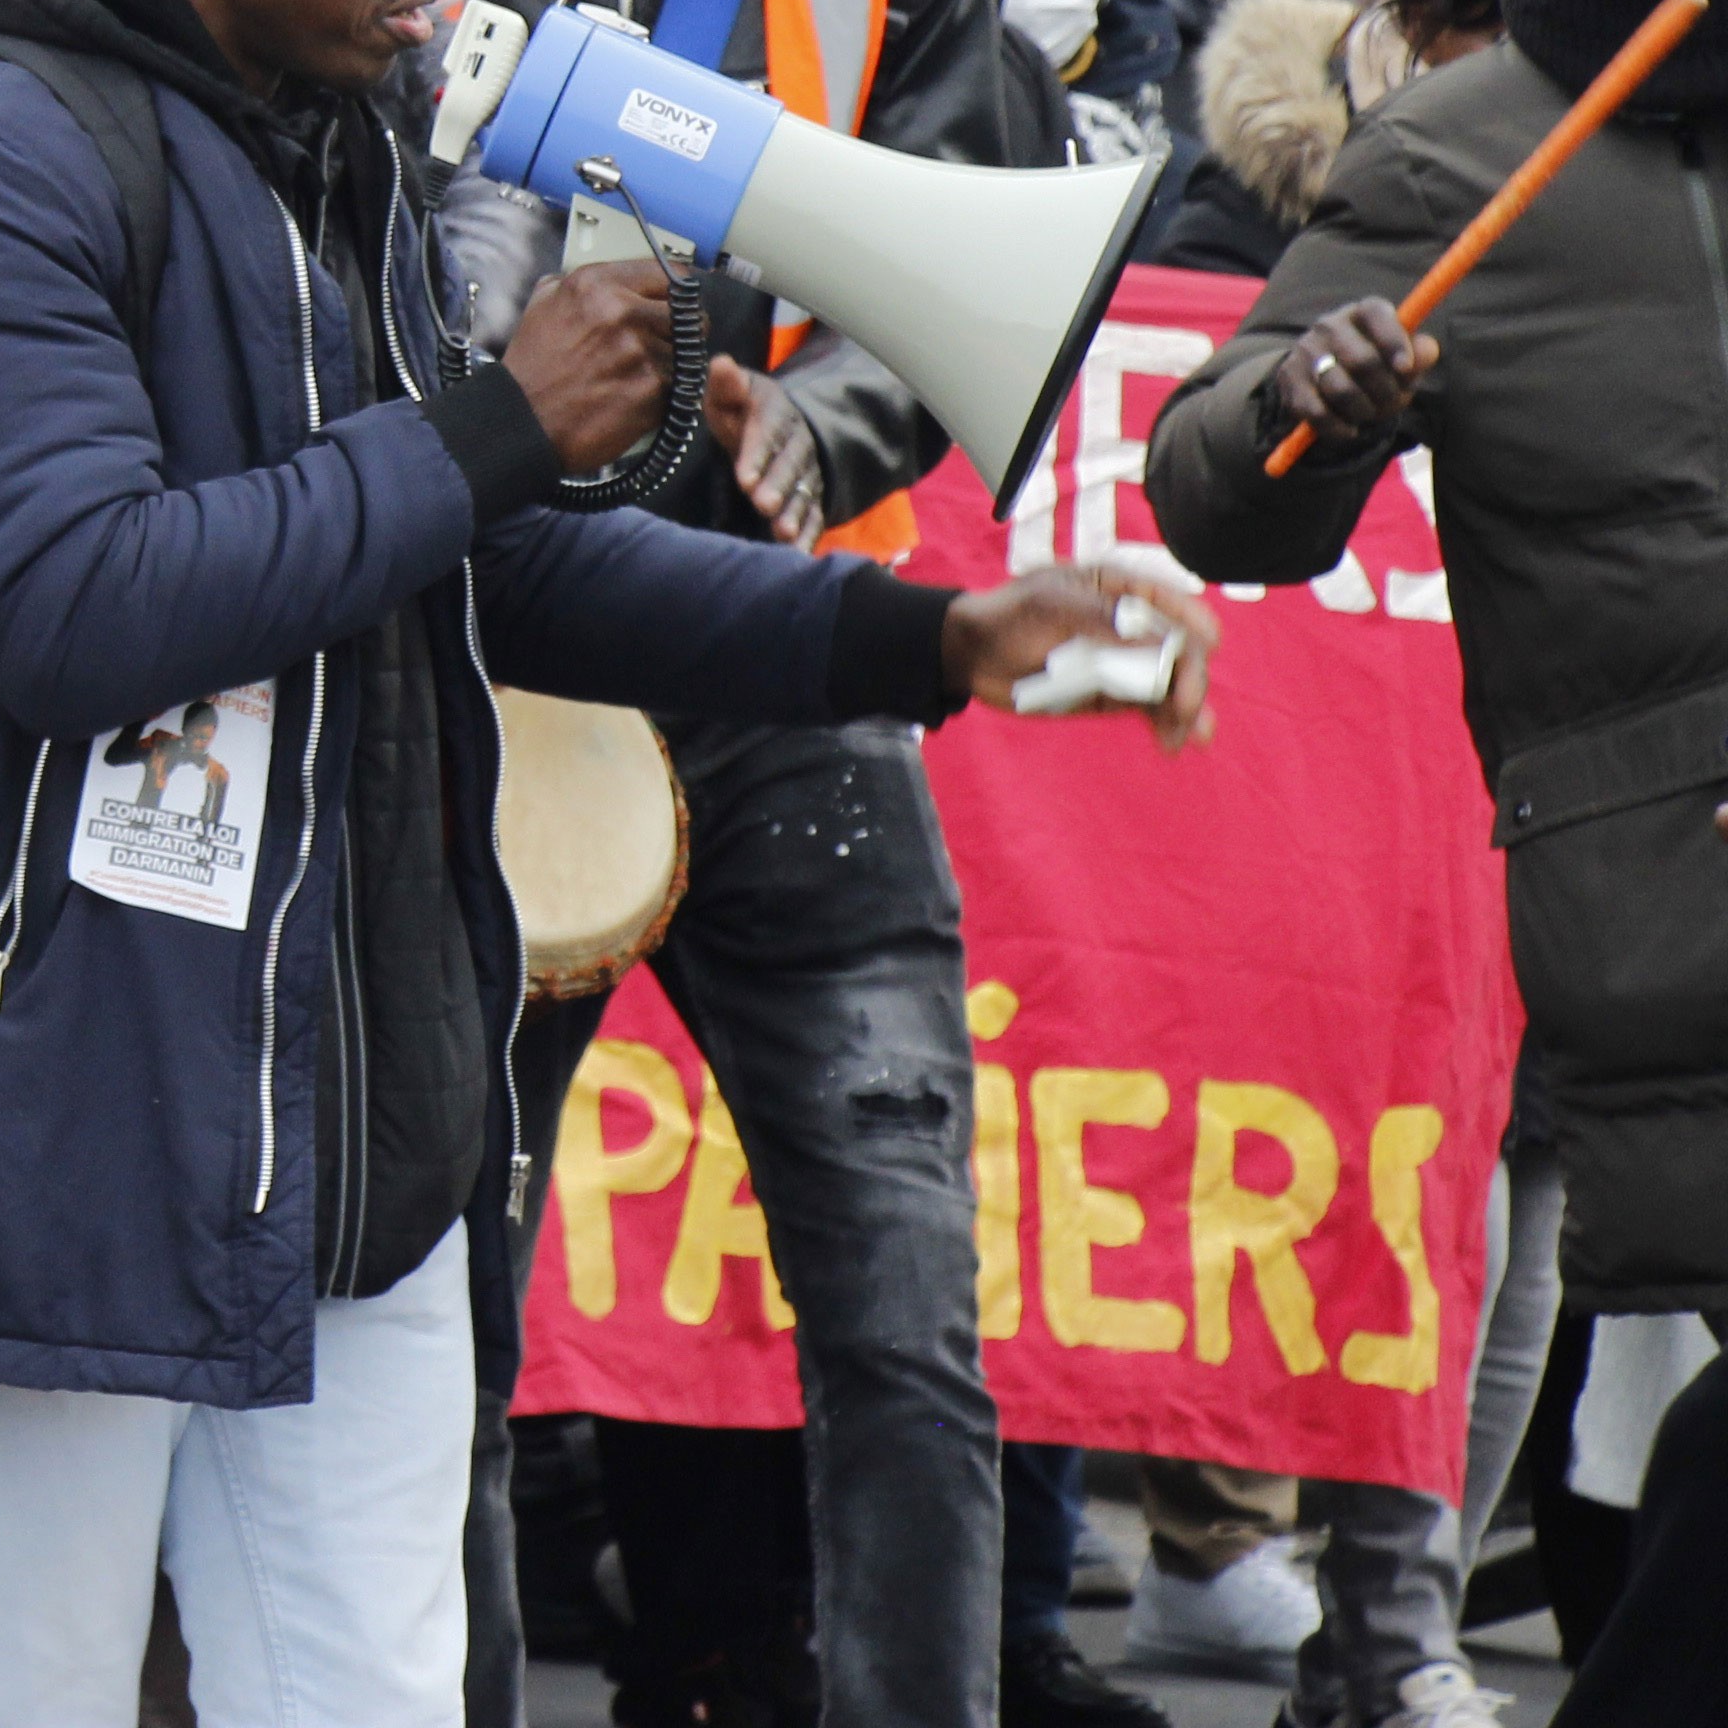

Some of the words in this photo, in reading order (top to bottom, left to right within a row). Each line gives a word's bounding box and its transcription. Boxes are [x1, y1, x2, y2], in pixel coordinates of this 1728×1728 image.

[637, 93, 712, 134] VONYX
[104, 801, 179, 828] CONTRE
[182, 817, 205, 836] LA
[208, 822, 237, 843] LOI
[90, 822, 214, 861] IMMIGRATION
[216, 849, 241, 869] DE
[113, 849, 213, 883] DARMANIN
[554, 979, 1443, 1394] PAIERS
